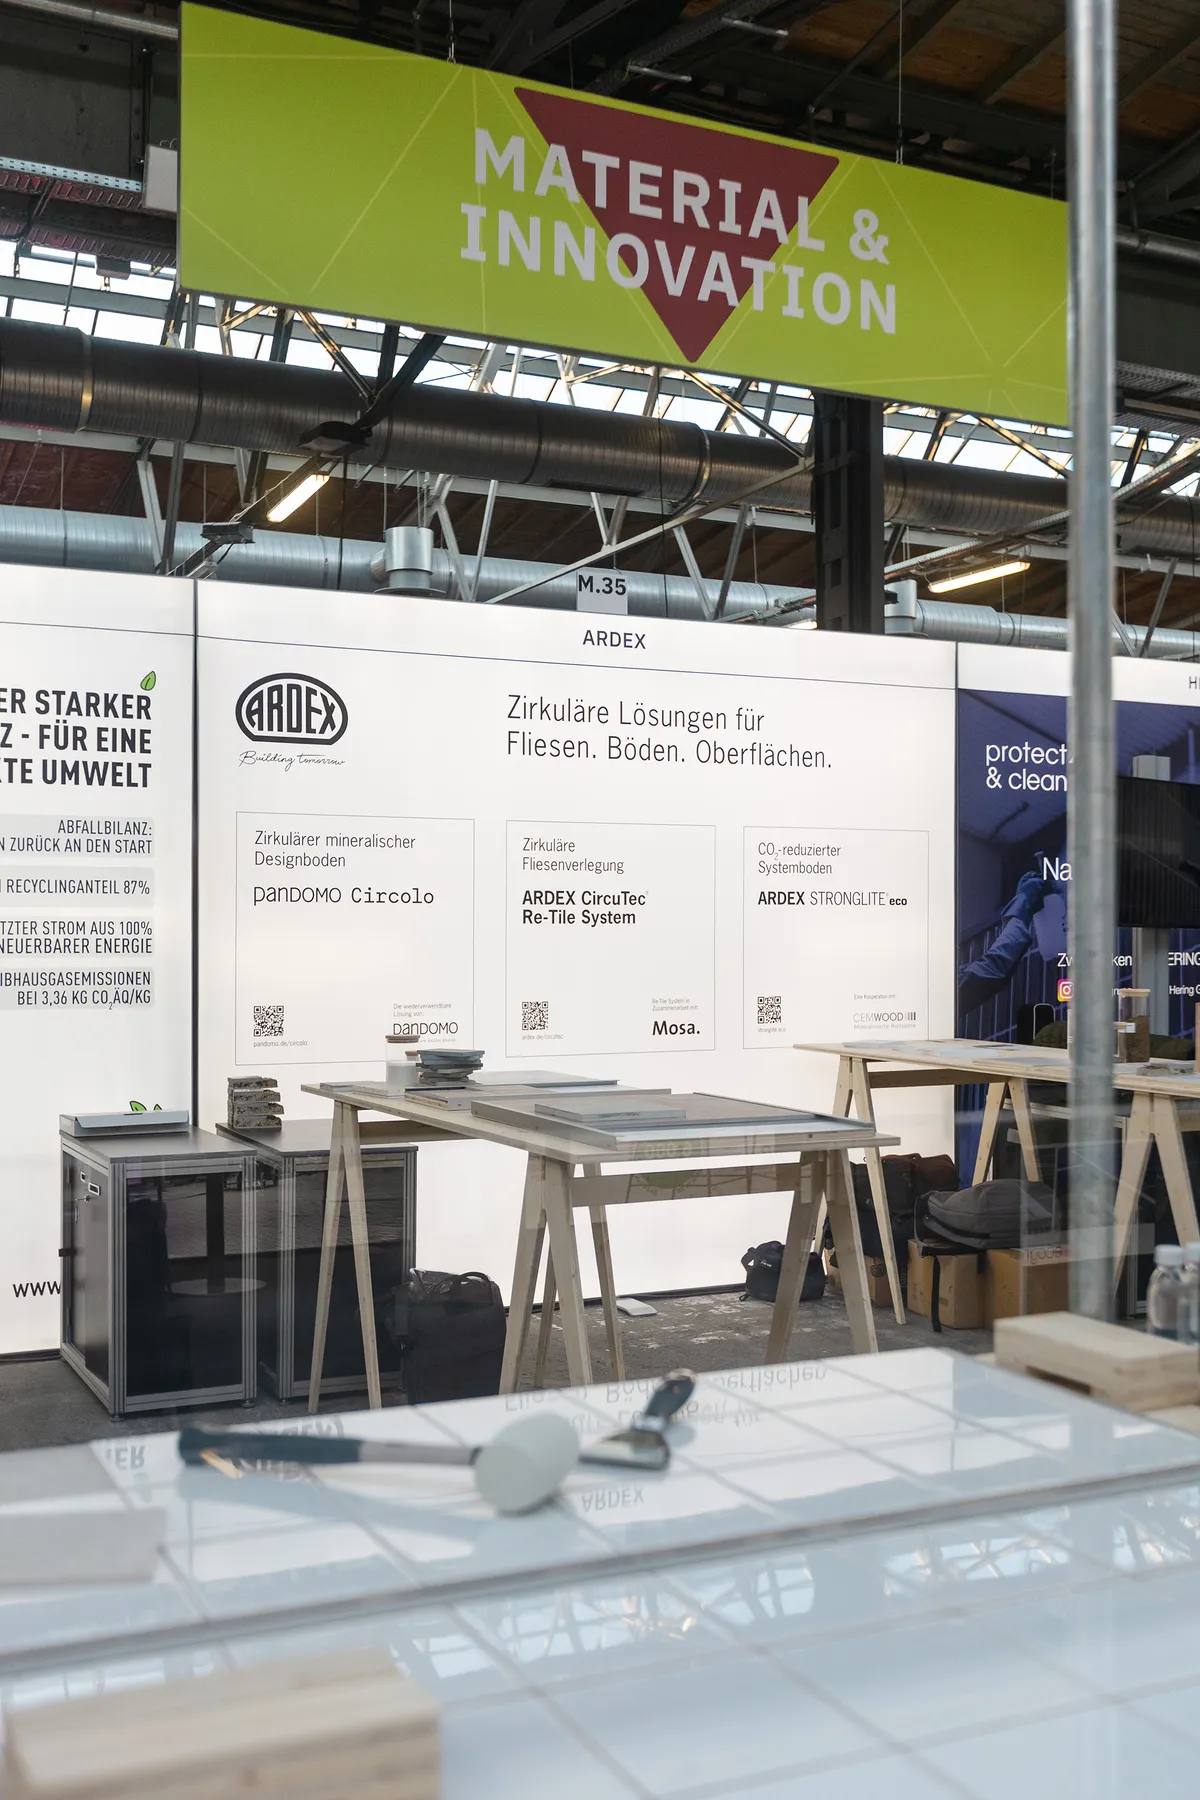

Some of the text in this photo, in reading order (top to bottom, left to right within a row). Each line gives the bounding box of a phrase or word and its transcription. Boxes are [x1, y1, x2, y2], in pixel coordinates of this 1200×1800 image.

[475, 128, 889, 265] MATERIAL &
[460, 202, 896, 335] INNOVATION
[578, 574, 627, 596] M.35
[583, 629, 646, 649] ARDEX
[35, 689, 152, 720] STARKER
[246, 683, 336, 735] ARDEX
[507, 694, 765, 733] Zirkuläre Lösungen für
[39, 719, 87, 751] FÜR
[97, 727, 151, 754] EINE
[507, 730, 832, 768] Fliesen. Böden. Oberflächen.
[239, 750, 345, 772] Building tomorrow
[0, 757, 152, 788] TE UMWELT
[986, 767, 1068, 791] & clean
[58, 819, 152, 836] ABFALLBILANZ:
[10, 835, 61, 852] ZURÜCK
[64, 838, 81, 853] AN
[86, 838, 110, 853] DEN
[115, 840, 153, 854] START
[254, 830, 416, 849] Zirkulärer mineralischer
[522, 837, 576, 852] Zirkuläre
[254, 851, 346, 870] Designboden
[522, 856, 625, 875] Fliesenverlegung
[758, 860, 833, 876] Systemboden
[6, 878, 150, 895] RECYCLINGANTEIL 87%
[351, 887, 434, 904] Circolo
[522, 890, 647, 906] ARDEX CircuTec
[758, 891, 805, 906] ARDEX
[889, 898, 908, 906] eco
[0, 920, 153, 936] TZTER STROM AUS 100%
[522, 909, 637, 928] Re-Tile System
[95, 938, 152, 954] ENERGIE
[18, 990, 37, 1005] BEI
[42, 990, 68, 1007] 3,36
[72, 990, 87, 1005] KG
[1169, 984, 1195, 997] Hering
[853, 1012, 904, 1022] CEMWOOD
[652, 1020, 701, 1036] Mosa.
